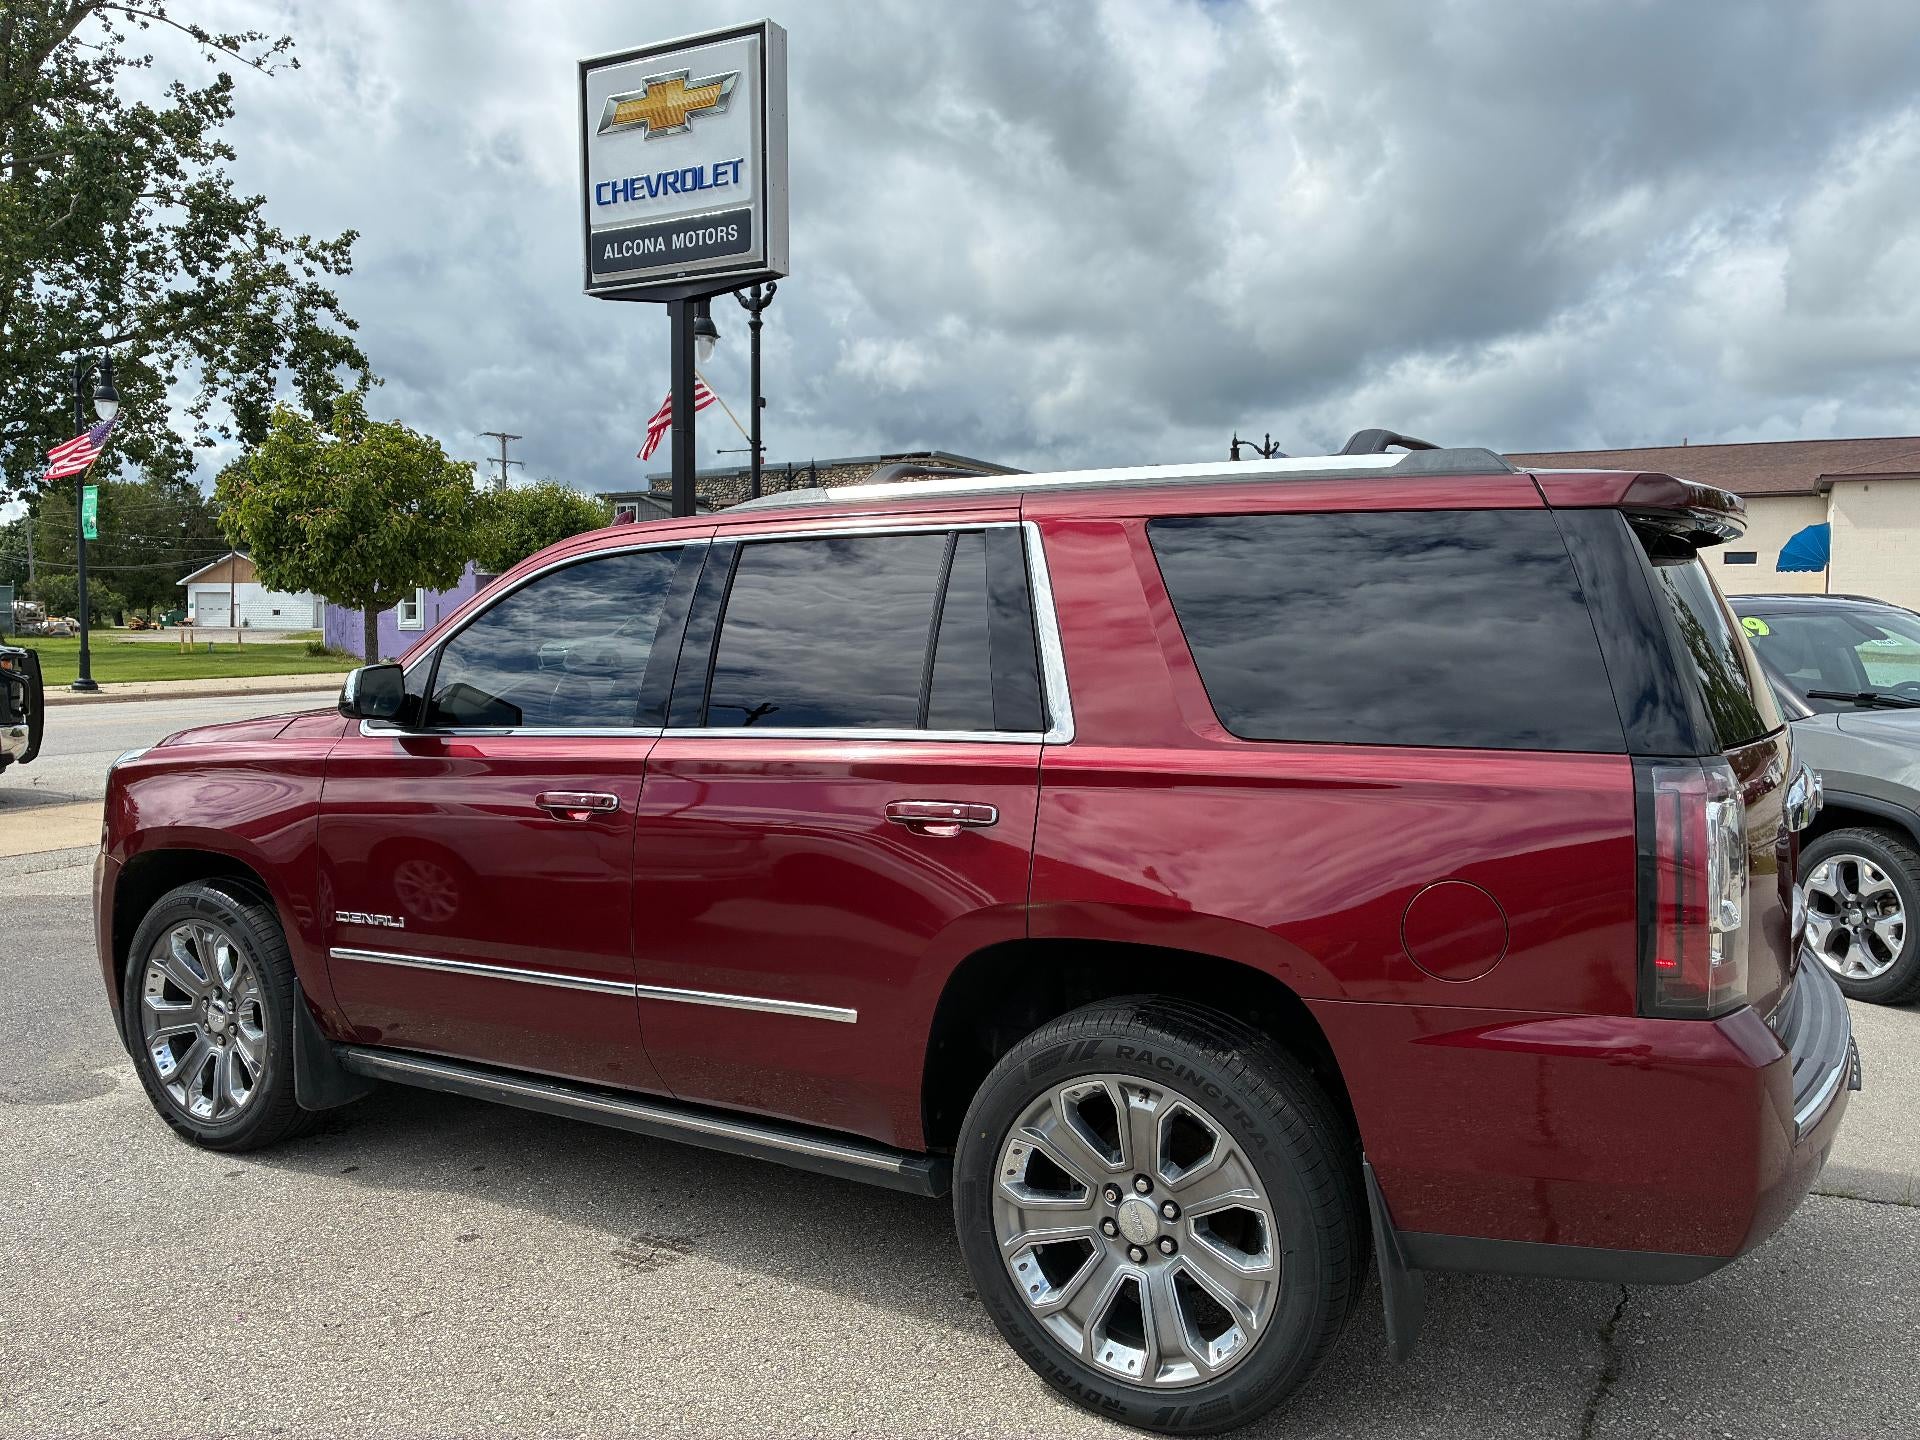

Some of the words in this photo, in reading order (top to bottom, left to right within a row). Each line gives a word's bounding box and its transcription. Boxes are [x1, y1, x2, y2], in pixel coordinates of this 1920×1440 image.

[595, 157, 744, 206] CHEVROLET
[603, 236, 666, 260] ALCONA
[672, 224, 738, 250] MOTORS
[335, 910, 405, 928] DENALI
